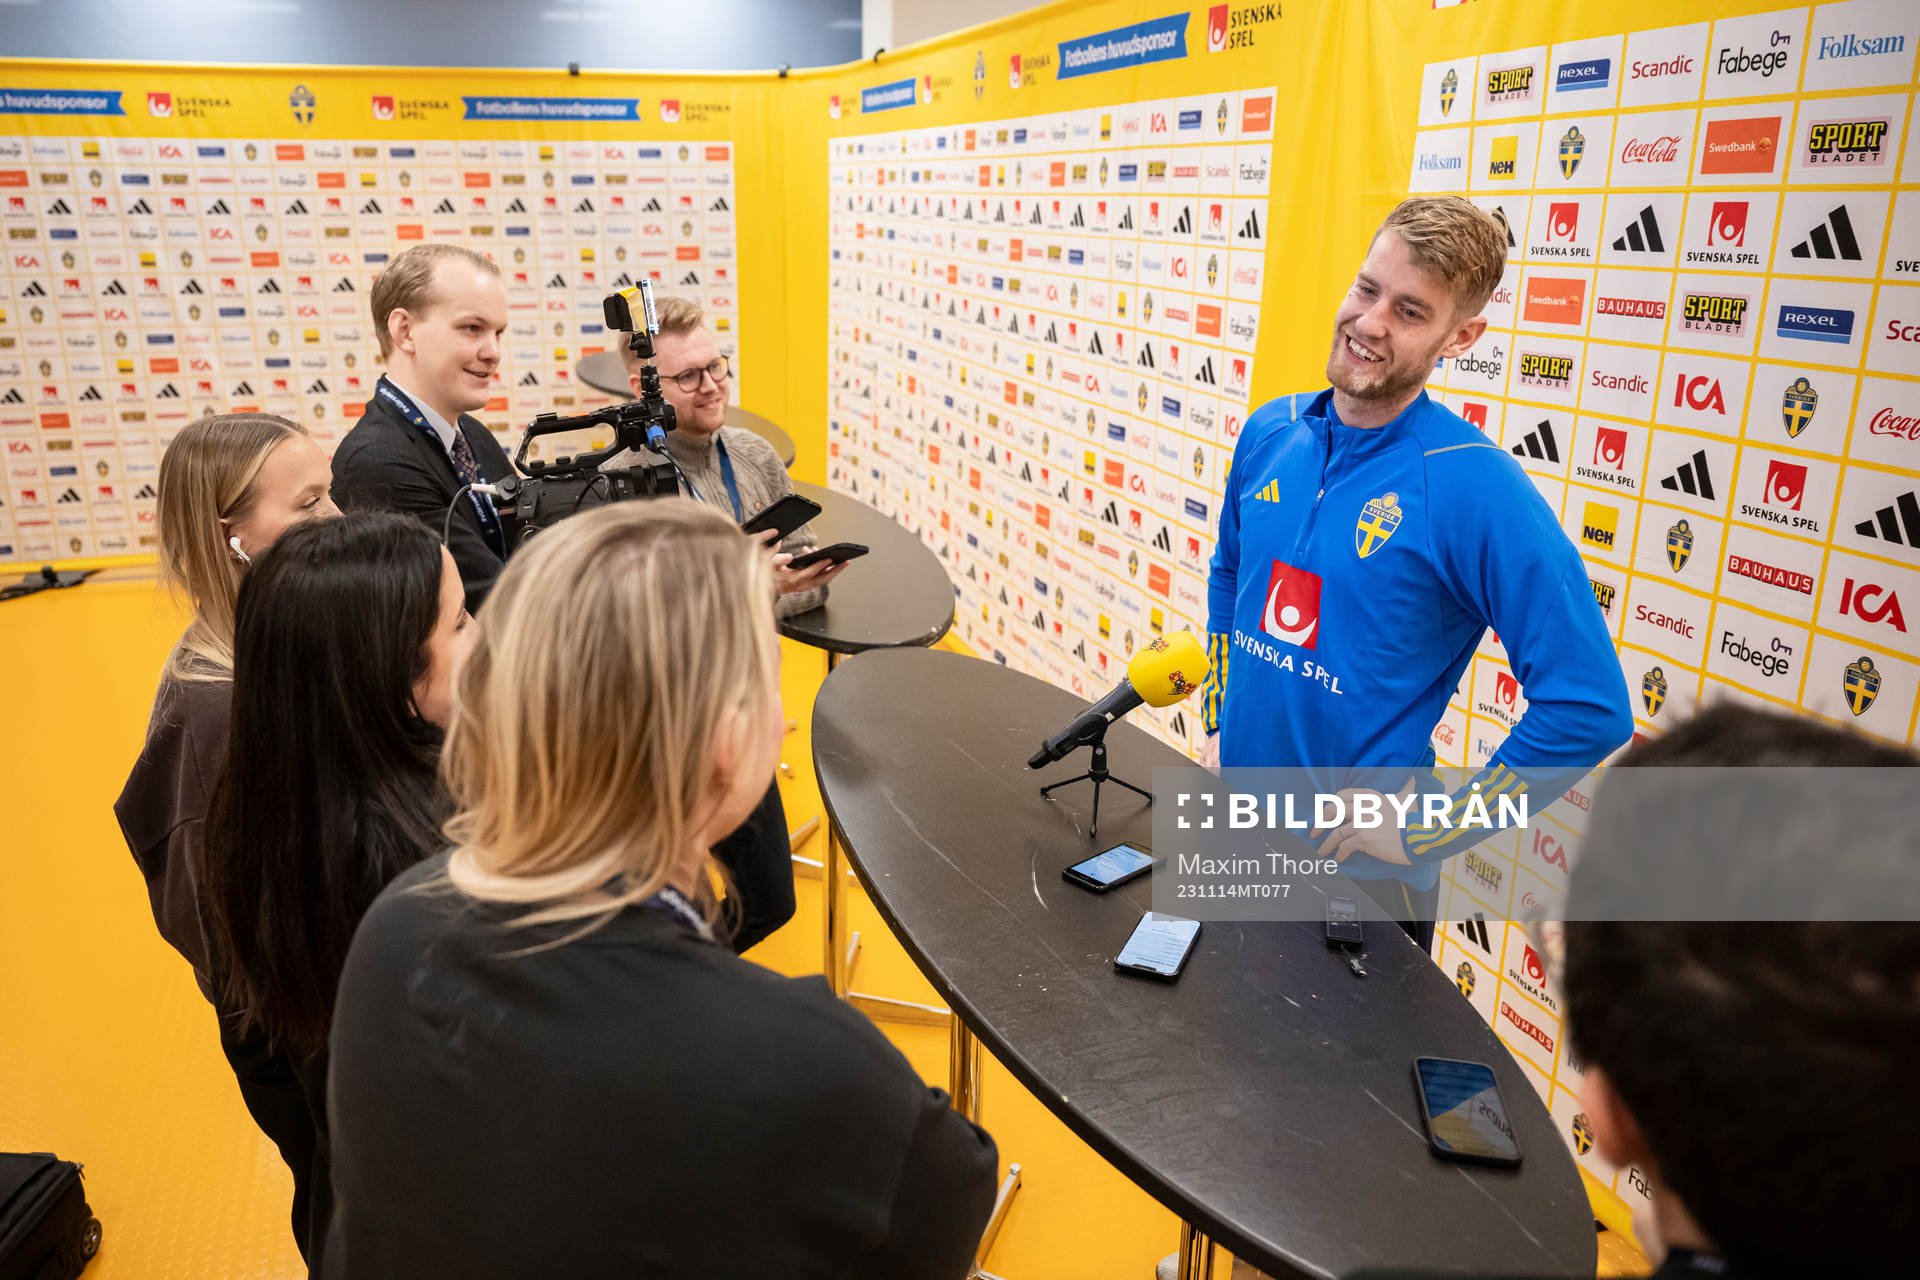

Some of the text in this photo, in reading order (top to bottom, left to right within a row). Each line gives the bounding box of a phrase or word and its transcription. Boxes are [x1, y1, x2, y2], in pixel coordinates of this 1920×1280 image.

[1231, 2, 1282, 28] SVENSKA
[1065, 29, 1177, 68] Fotbollens huvudsponsor
[1230, 31, 1255, 49] SPEL
[1817, 33, 1904, 60] Folksam
[1631, 54, 1693, 79] Scandic
[1718, 46, 1788, 78] Fabege
[1488, 66, 1533, 95] SPORT
[1151, 112, 1167, 134] ICA
[1709, 140, 1756, 153] Swedbank
[1809, 121, 1887, 154] SPORT
[1418, 153, 1461, 171] Folksam
[1810, 152, 1880, 163] BLADET
[15, 255, 39, 268] ICA
[1531, 246, 1591, 257] SVENSKA SPEL
[1687, 251, 1760, 265] SVENSKA SPEL
[1529, 294, 1567, 306] Swedbank
[1598, 297, 1665, 318] BAUHAUS
[1684, 295, 1748, 325] SPORT
[1685, 321, 1741, 334] BLADET
[1521, 354, 1573, 381] SPORT
[1520, 377, 1569, 389] BLADET
[1591, 370, 1649, 394] Scandic
[1674, 373, 1726, 415] ICA
[1576, 466, 1636, 489] SVENSKA SPEL
[1741, 504, 1820, 533] SVENSKA SPEL
[1729, 555, 1812, 592] BAUHAUS
[1839, 578, 1907, 633] ICA
[1635, 604, 1695, 640] Scandic
[1234, 629, 1344, 695] SVENSKA SPEL
[1721, 630, 1789, 677] Fabege
[1478, 703, 1509, 722] SVENSKA
[1532, 828, 1569, 876] ICA
[1464, 850, 1502, 888] SPORT
[1509, 968, 1557, 1011] SVENSKA SPEL
[1501, 1002, 1553, 1053] BAUHAUS
